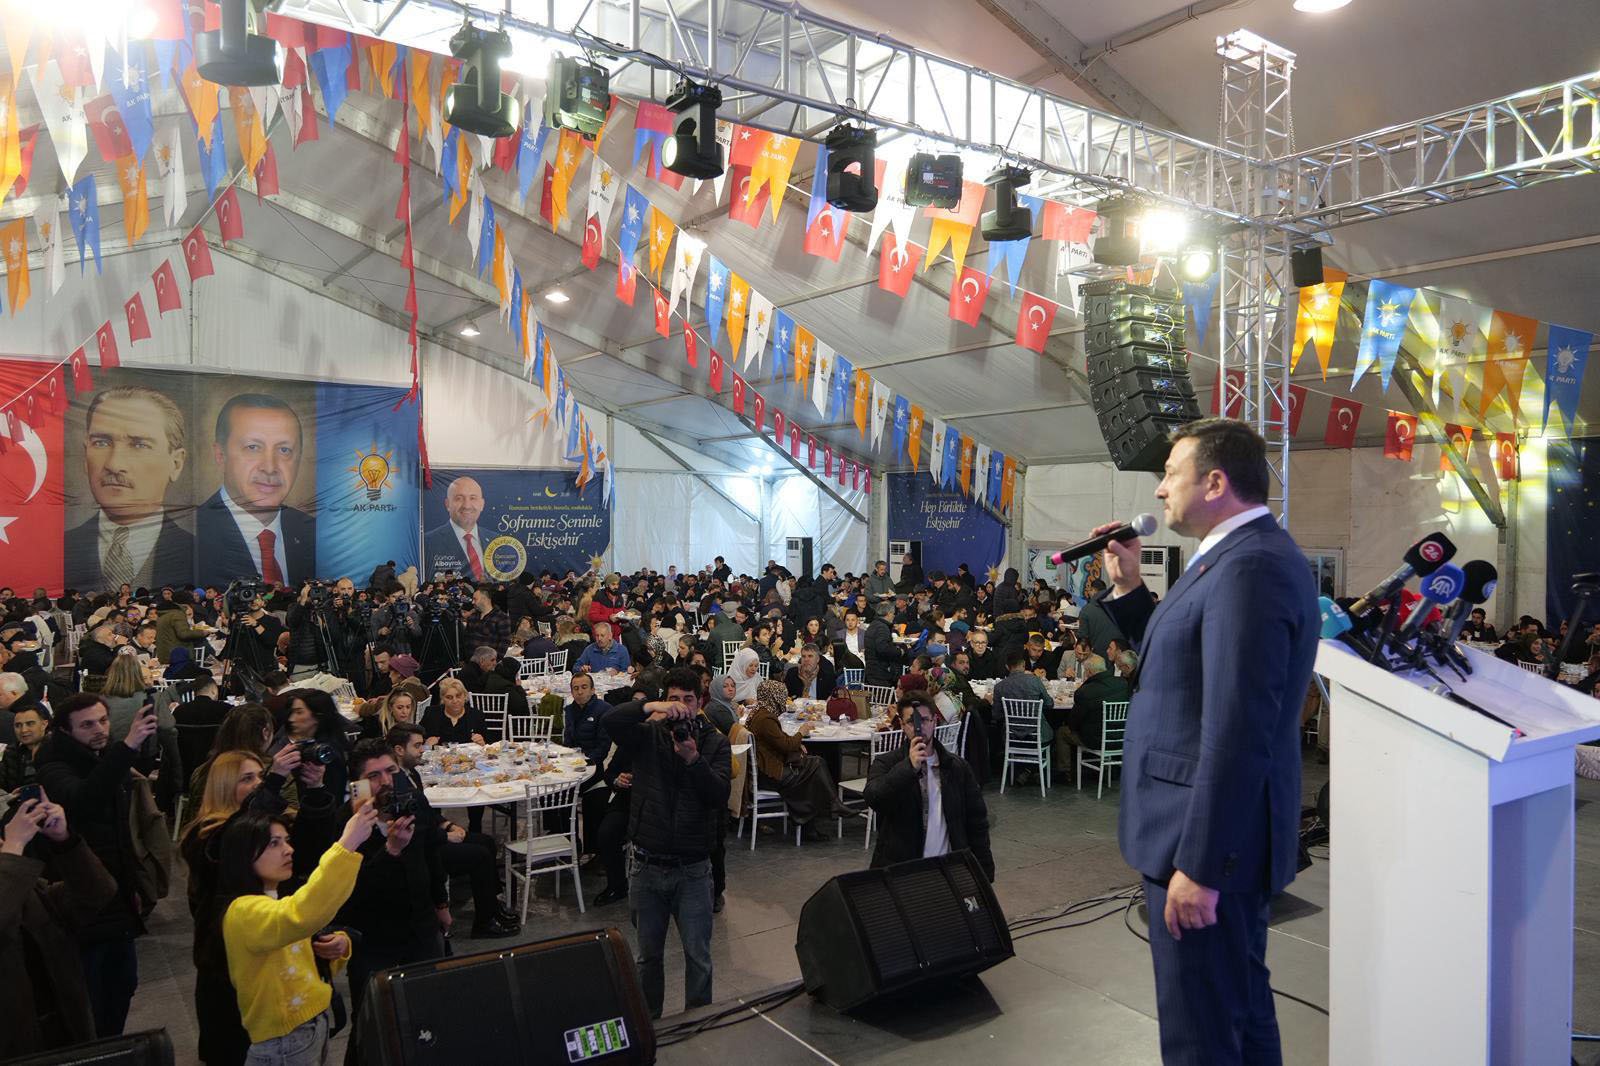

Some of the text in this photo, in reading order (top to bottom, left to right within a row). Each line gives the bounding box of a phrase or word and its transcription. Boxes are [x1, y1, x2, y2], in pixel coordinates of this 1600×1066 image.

[353, 503, 366, 512] AK
[920, 501, 967, 517] Hep Birlikte
[498, 513, 602, 533] Soframız Seninle
[925, 516, 964, 531] Eskişehir
[526, 532, 584, 549] Eskişehir
